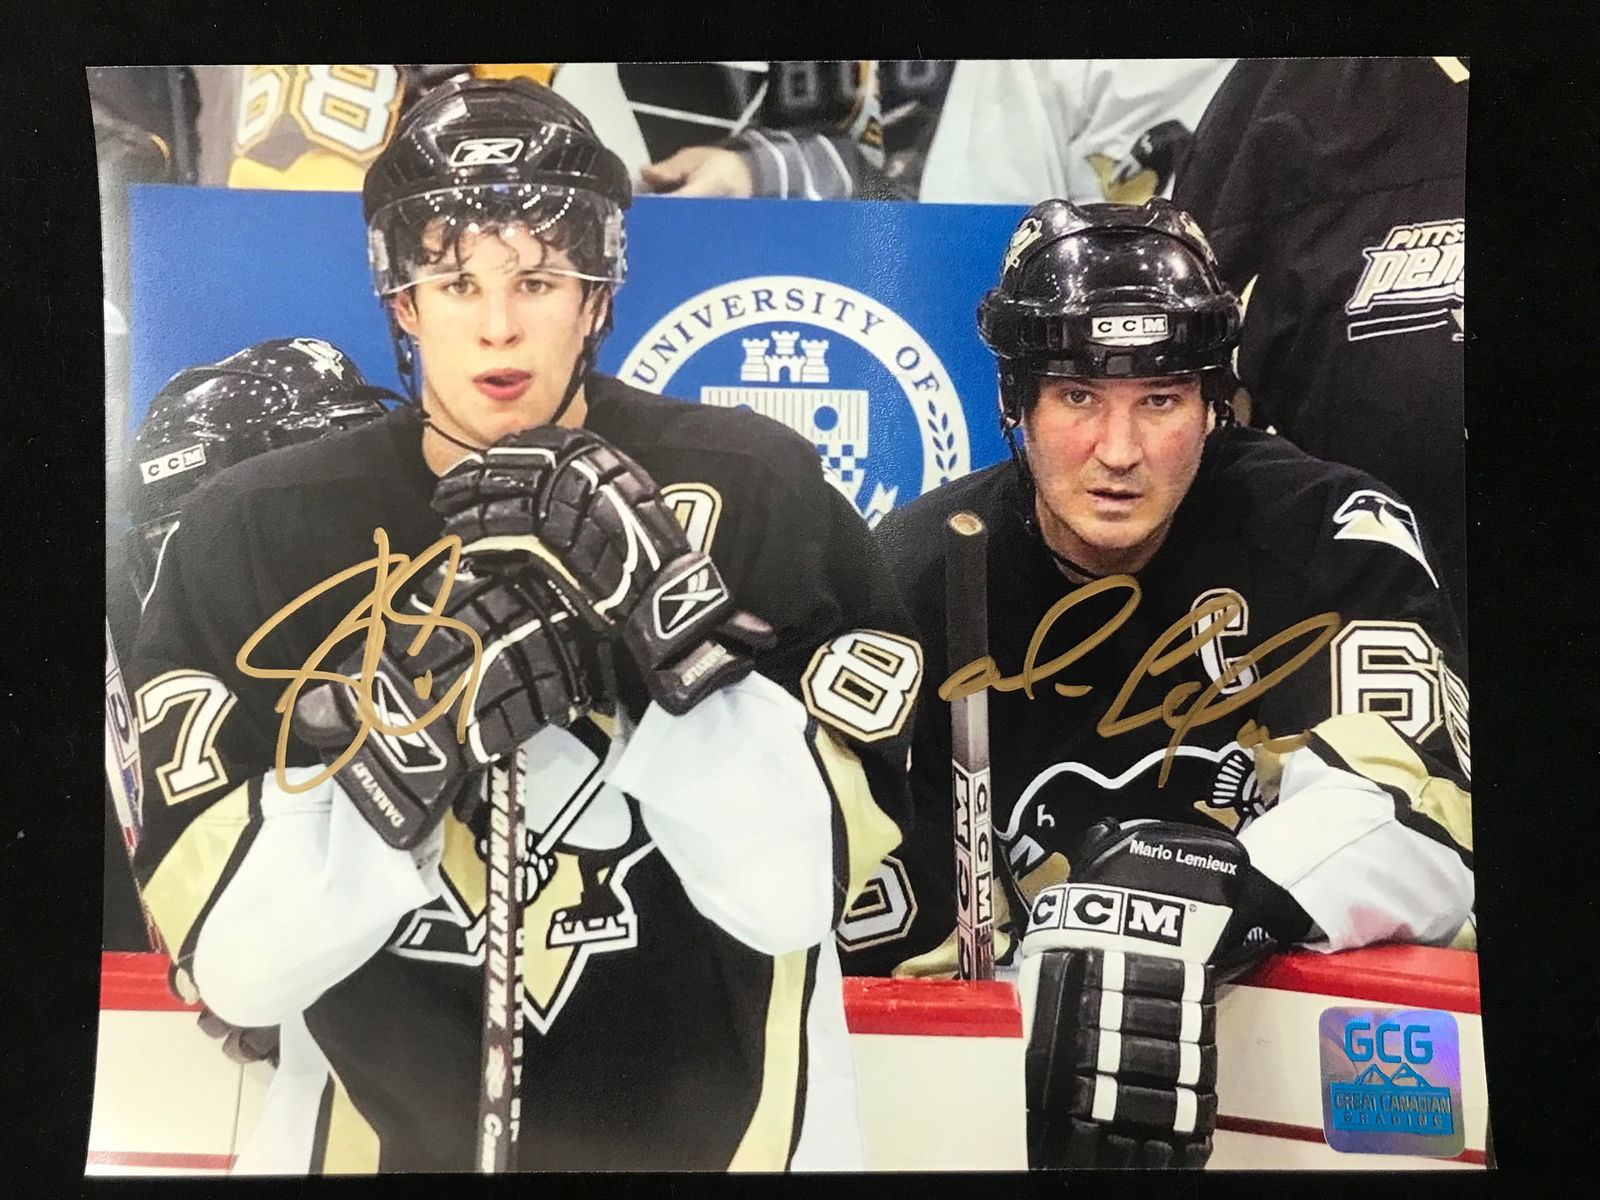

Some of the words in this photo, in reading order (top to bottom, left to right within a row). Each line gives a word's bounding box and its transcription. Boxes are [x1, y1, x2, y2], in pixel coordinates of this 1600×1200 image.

[1097, 315, 1166, 334] CCM
[632, 288, 885, 385] UNIVERSITY
[896, 345, 940, 395] OF
[147, 446, 204, 477] CCM
[137, 668, 238, 806] 7
[1129, 840, 1173, 861] Mario
[1175, 848, 1238, 876] Lemieux
[1344, 1020, 1434, 1065] GCG
[1335, 1093, 1377, 1111] GREAT
[1381, 1094, 1451, 1114] CANADIAN
[1343, 1111, 1443, 1127] GRADING
